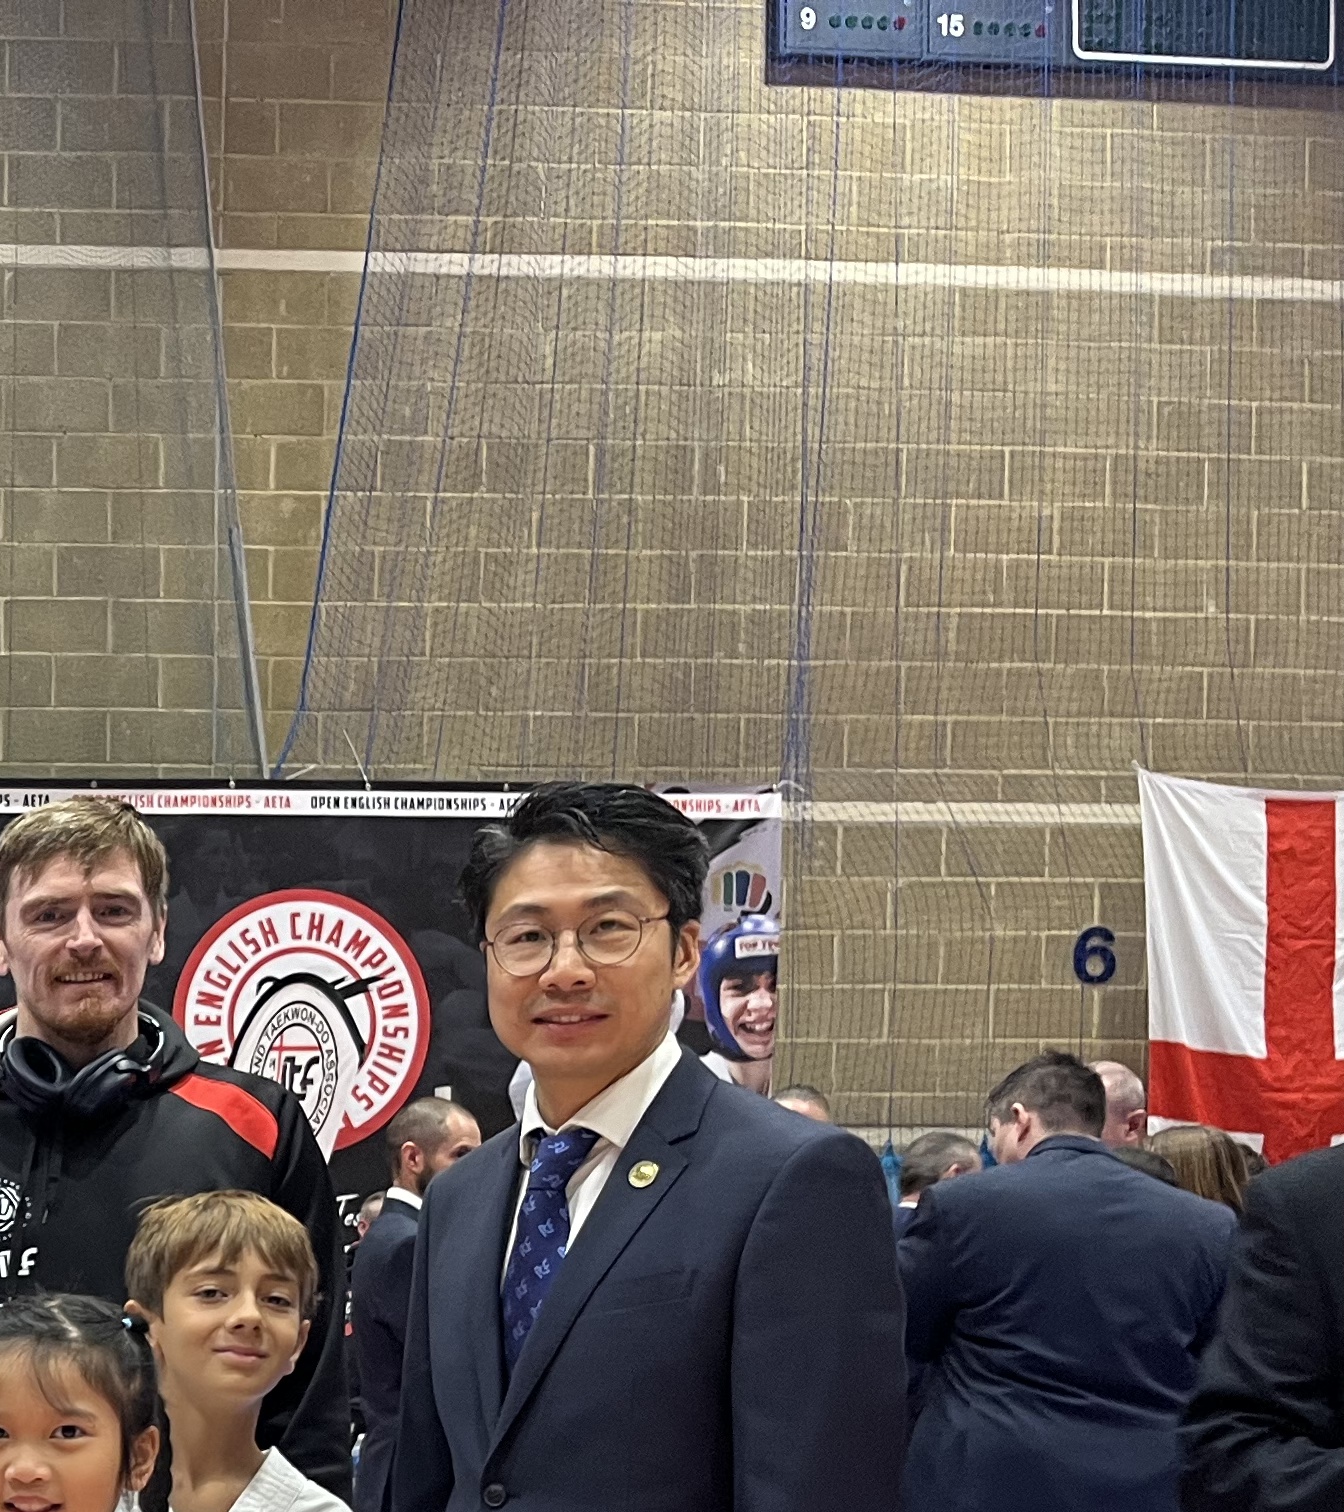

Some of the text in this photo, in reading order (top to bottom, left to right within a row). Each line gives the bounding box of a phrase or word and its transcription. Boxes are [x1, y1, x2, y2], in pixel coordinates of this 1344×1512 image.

[800, 7, 816, 30] 9
[937, 14, 965, 37] 15
[157, 795, 252, 808] CHAMPIONSHIPS
[311, 796, 340, 809] OPEN
[344, 797, 390, 810] ENGLISH
[394, 797, 487, 811] CHAMPIONSHIPS
[194, 917, 279, 1027] ENGLISH
[1073, 927, 1116, 984] 6
[289, 912, 409, 1112] CHAMPIONSHIPS
[264, 1006, 330, 1044] TAEKWON-DO
[312, 1050, 337, 1133] ASSOCIA
